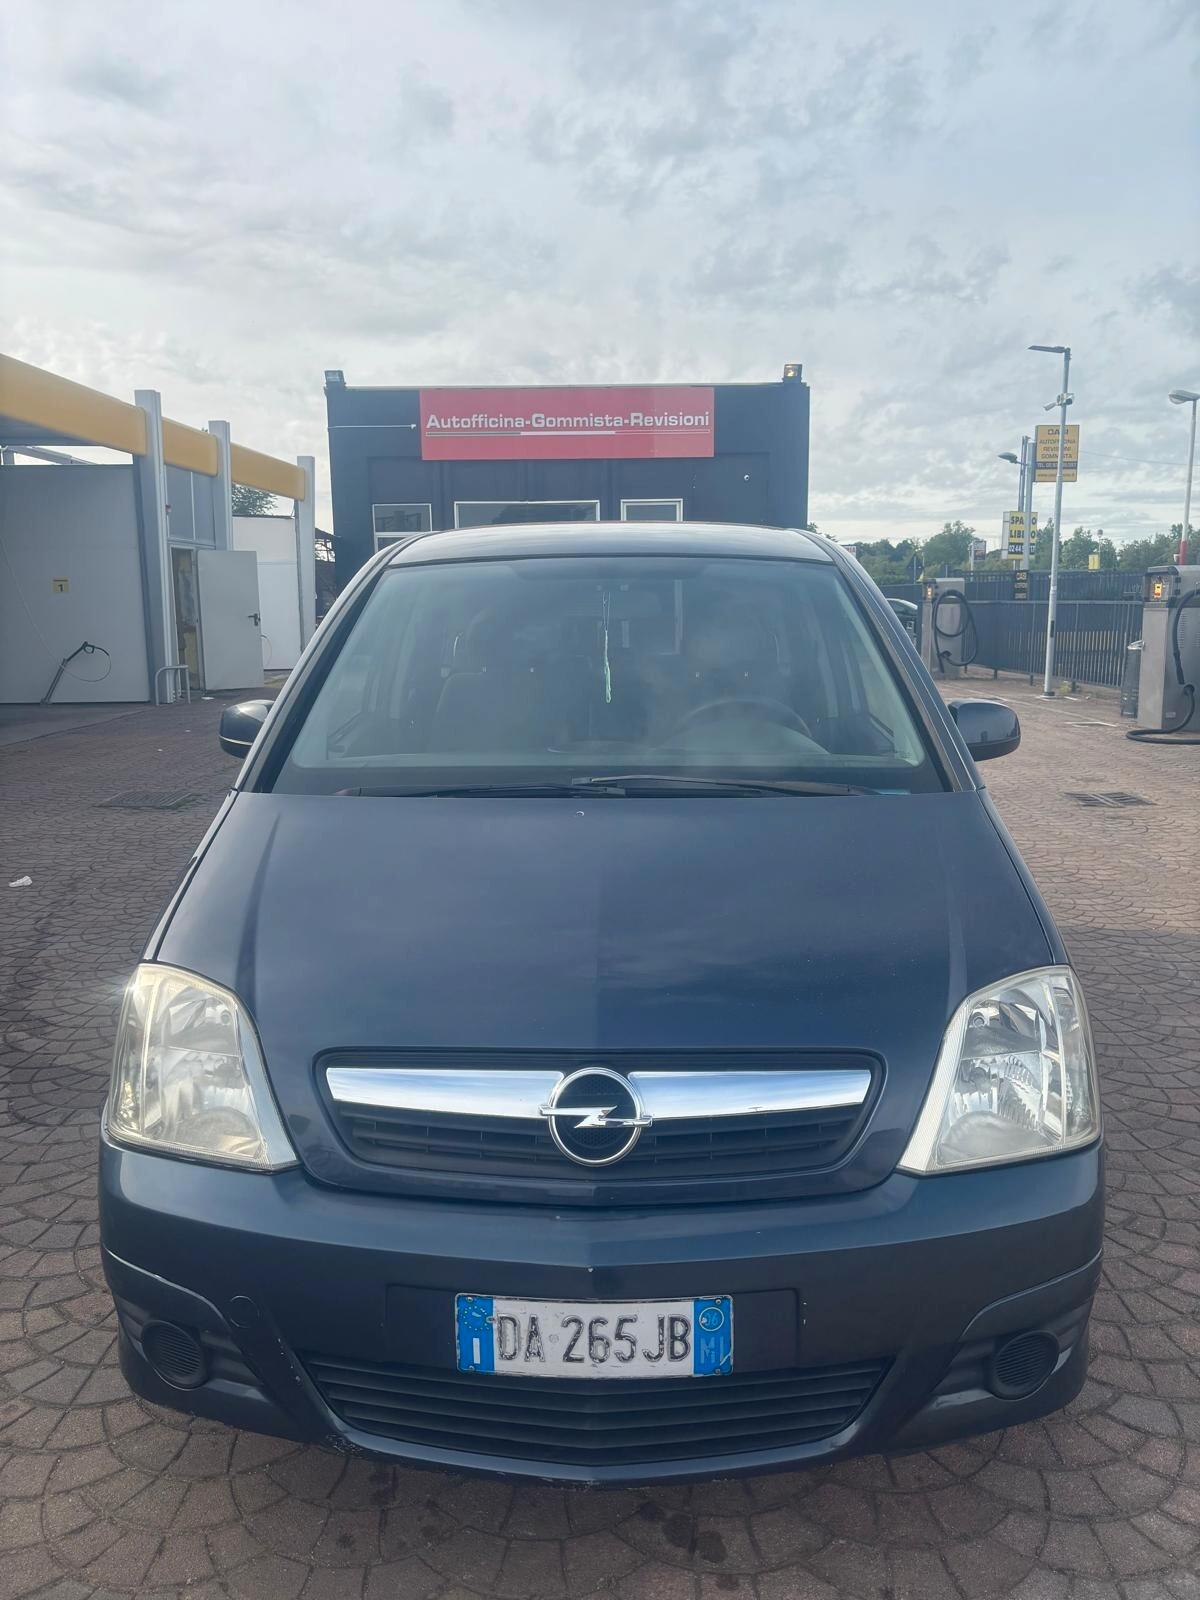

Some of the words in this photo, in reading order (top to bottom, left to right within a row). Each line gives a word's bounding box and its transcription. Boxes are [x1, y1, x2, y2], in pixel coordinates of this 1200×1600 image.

[426, 411, 710, 429] Autofficina-Gommista-Revisioni
[1010, 516, 1037, 525] SPAO
[57, 583, 64, 593] 1
[497, 1313, 546, 1363] DA
